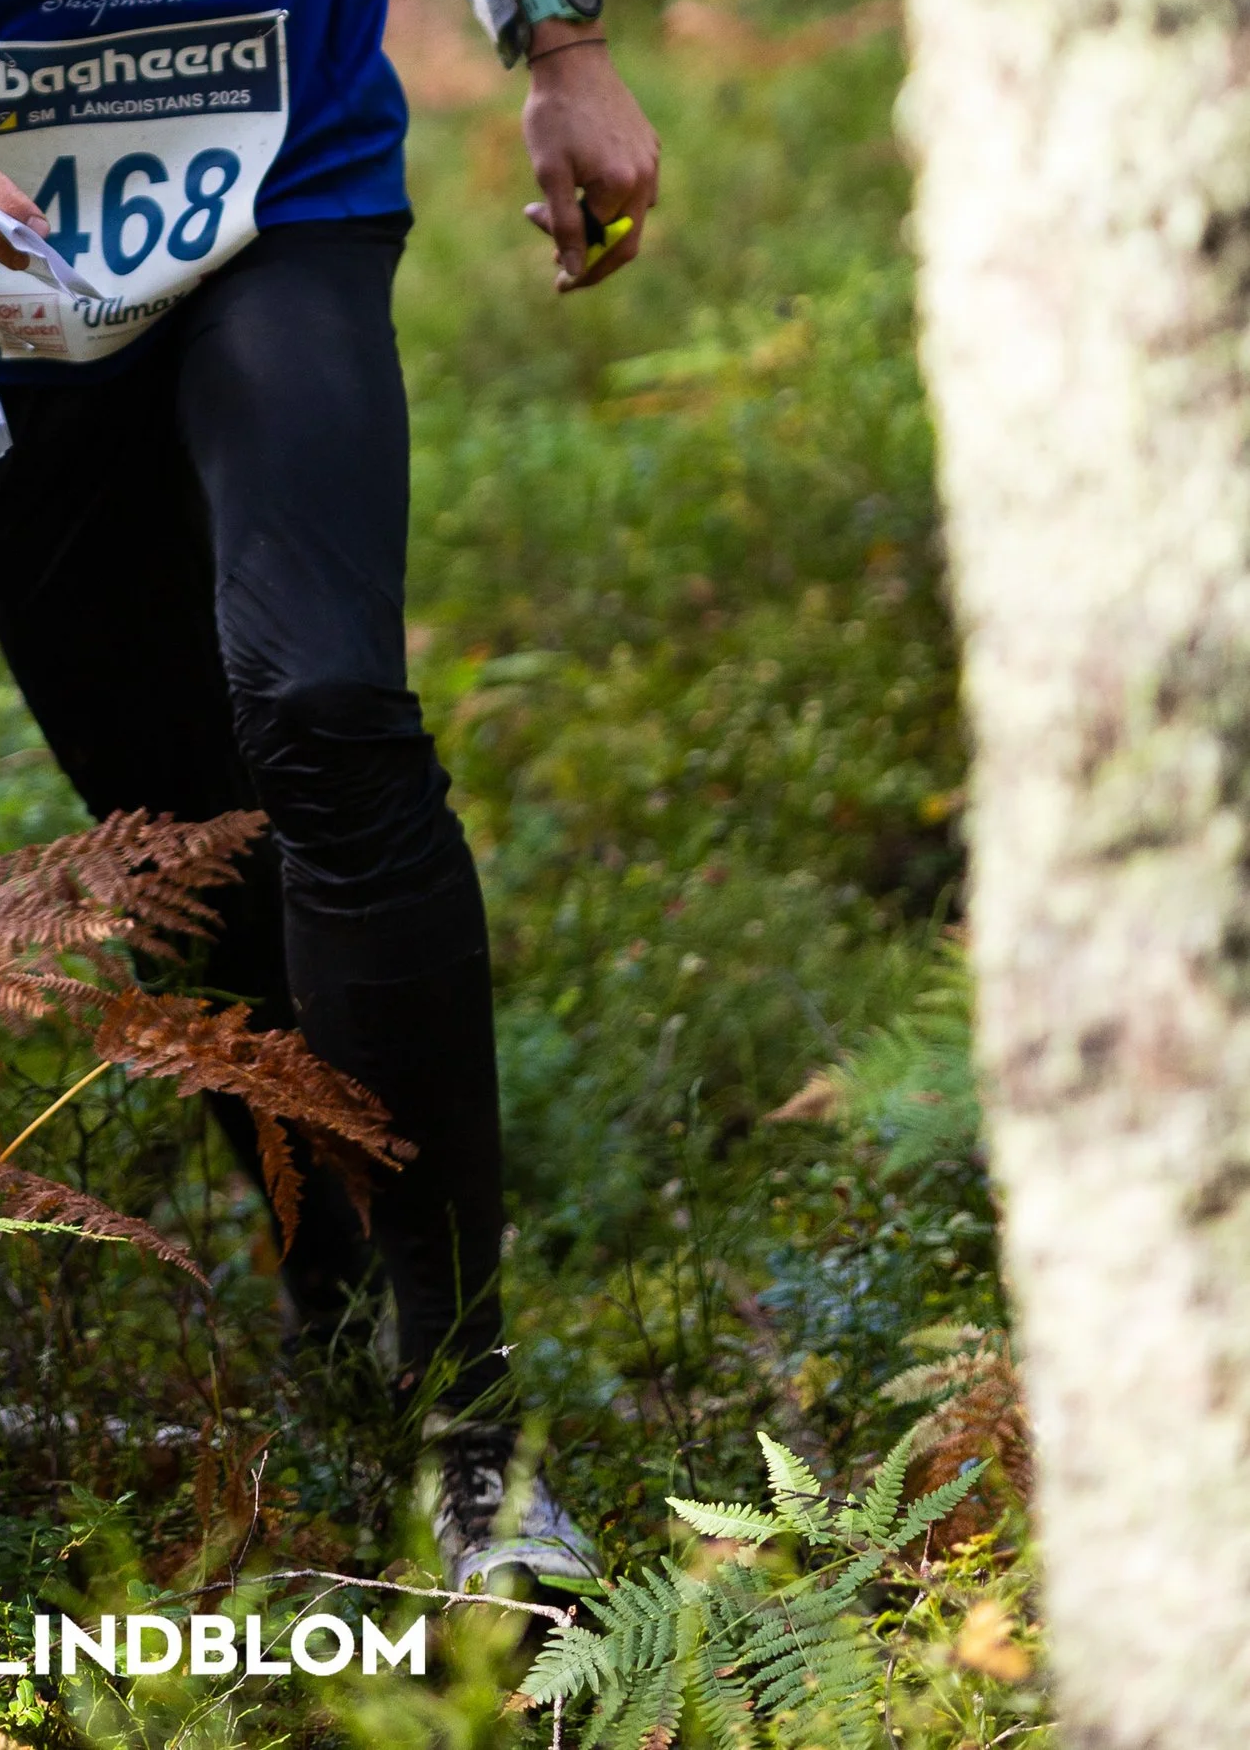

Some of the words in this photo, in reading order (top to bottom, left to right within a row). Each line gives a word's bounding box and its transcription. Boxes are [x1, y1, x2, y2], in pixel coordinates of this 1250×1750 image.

[28, 107, 55, 123] SM
[209, 89, 251, 105] 2025
[34, 147, 241, 275] 468
